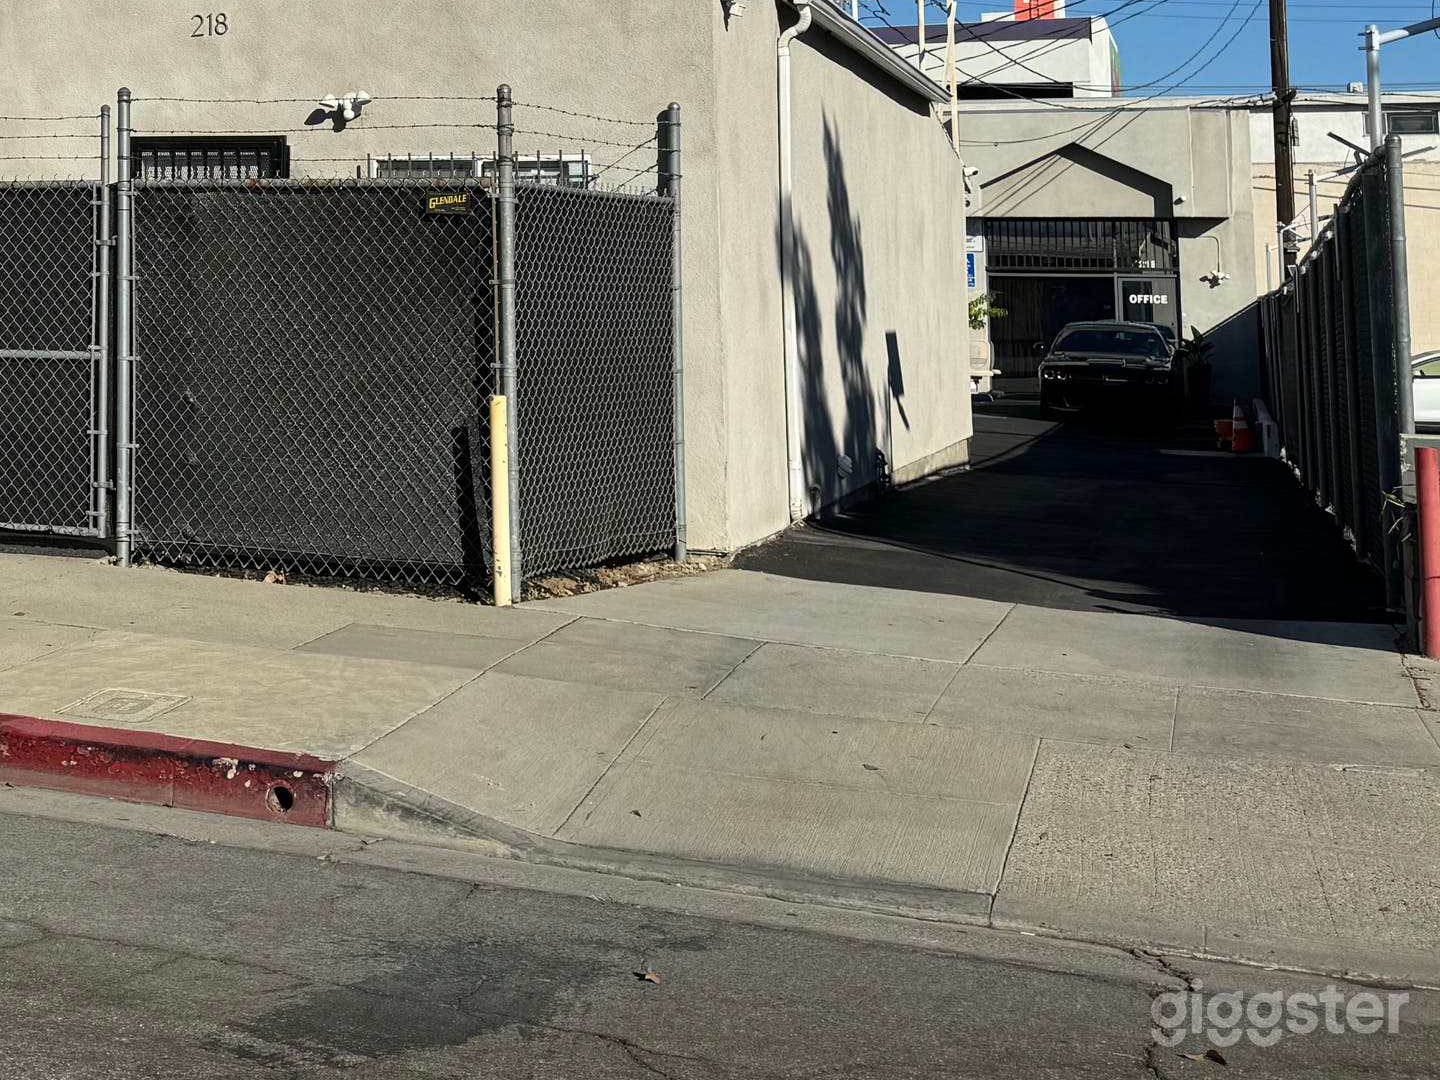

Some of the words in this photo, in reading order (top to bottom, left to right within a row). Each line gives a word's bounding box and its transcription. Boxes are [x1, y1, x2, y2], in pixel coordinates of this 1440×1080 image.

[191, 13, 228, 37] 218
[429, 194, 468, 209] GLENDALE
[1129, 294, 1168, 305] OFFICE
